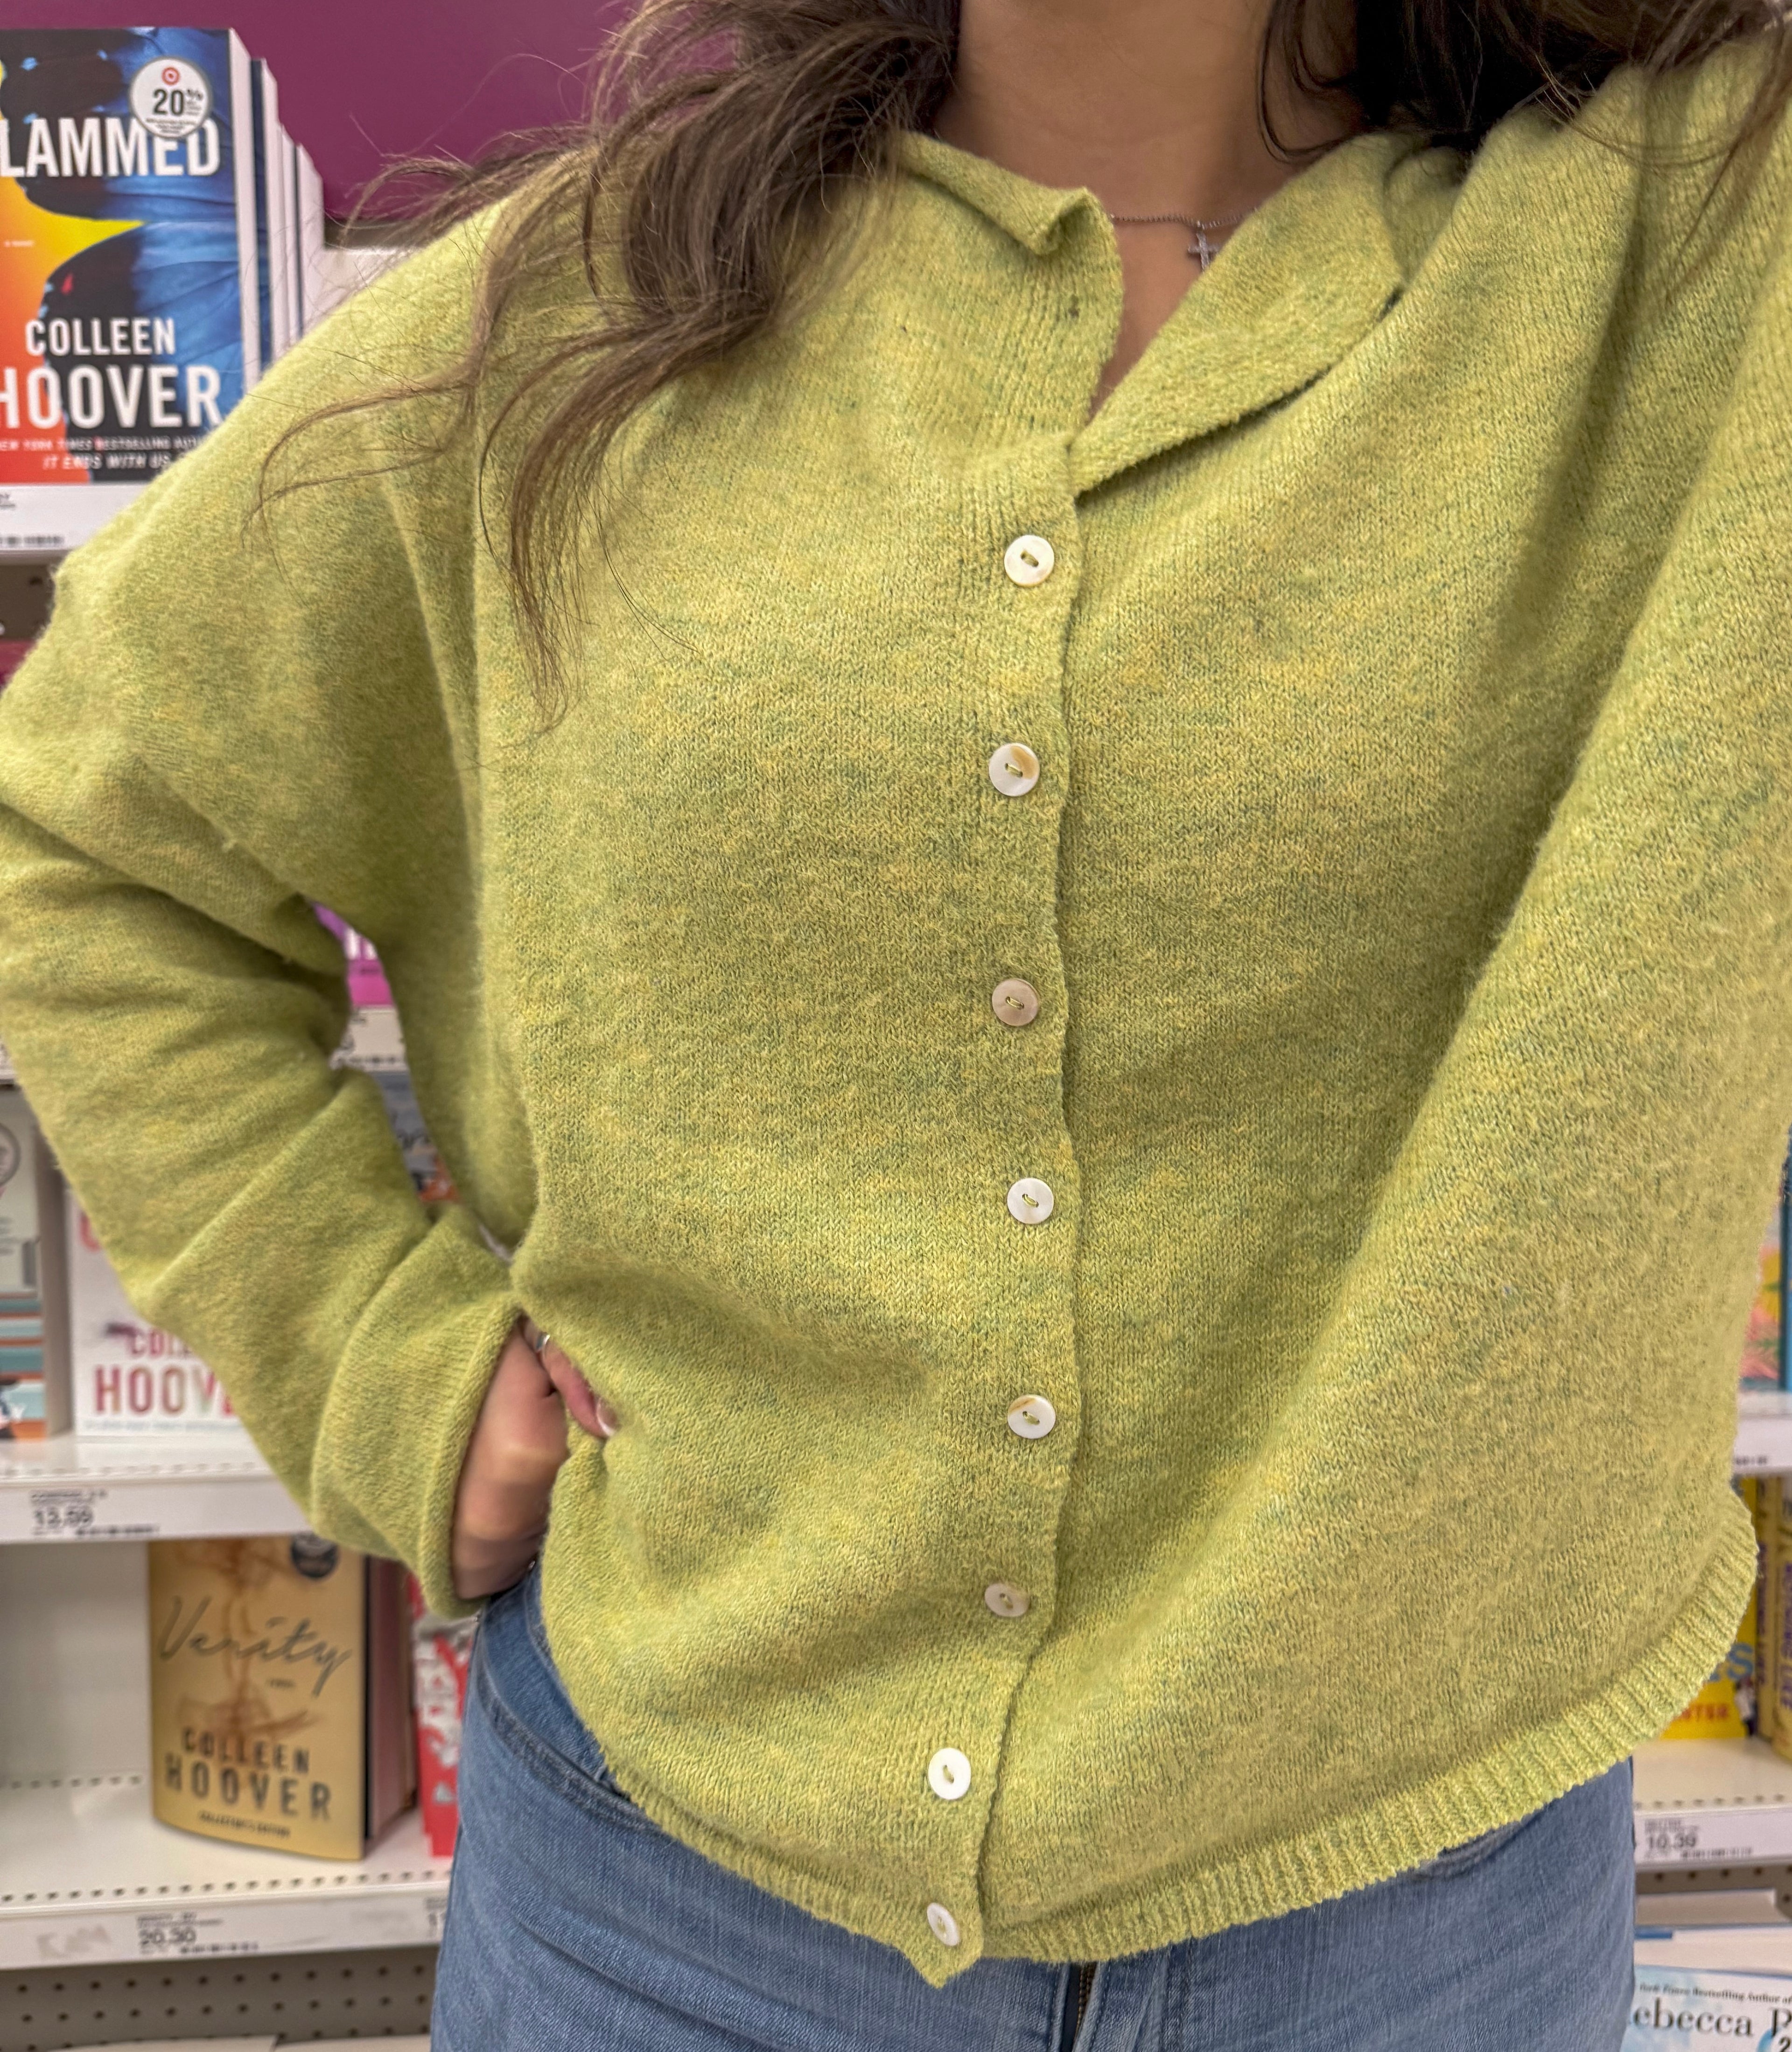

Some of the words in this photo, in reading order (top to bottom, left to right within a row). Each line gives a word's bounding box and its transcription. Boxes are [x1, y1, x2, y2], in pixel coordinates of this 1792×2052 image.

[0, 118, 220, 177] LAMMED
[25, 318, 176, 356] COLLEEN
[0, 363, 225, 429] HOOVER
[43, 454, 58, 470] IT
[63, 453, 102, 469] ENDS
[105, 452, 147, 468] WITH
[56, 437, 93, 450] TIMES
[94, 436, 171, 450] BESTSELLING
[158, 1595, 352, 1699] Verity
[183, 1727, 310, 1775] COLLEEN
[164, 1753, 332, 1820] HOOVER
[1629, 1996, 1753, 2037] ebecca
[1693, 1987, 1745, 2002] Bestselling
[1747, 1992, 1780, 2003] Author
